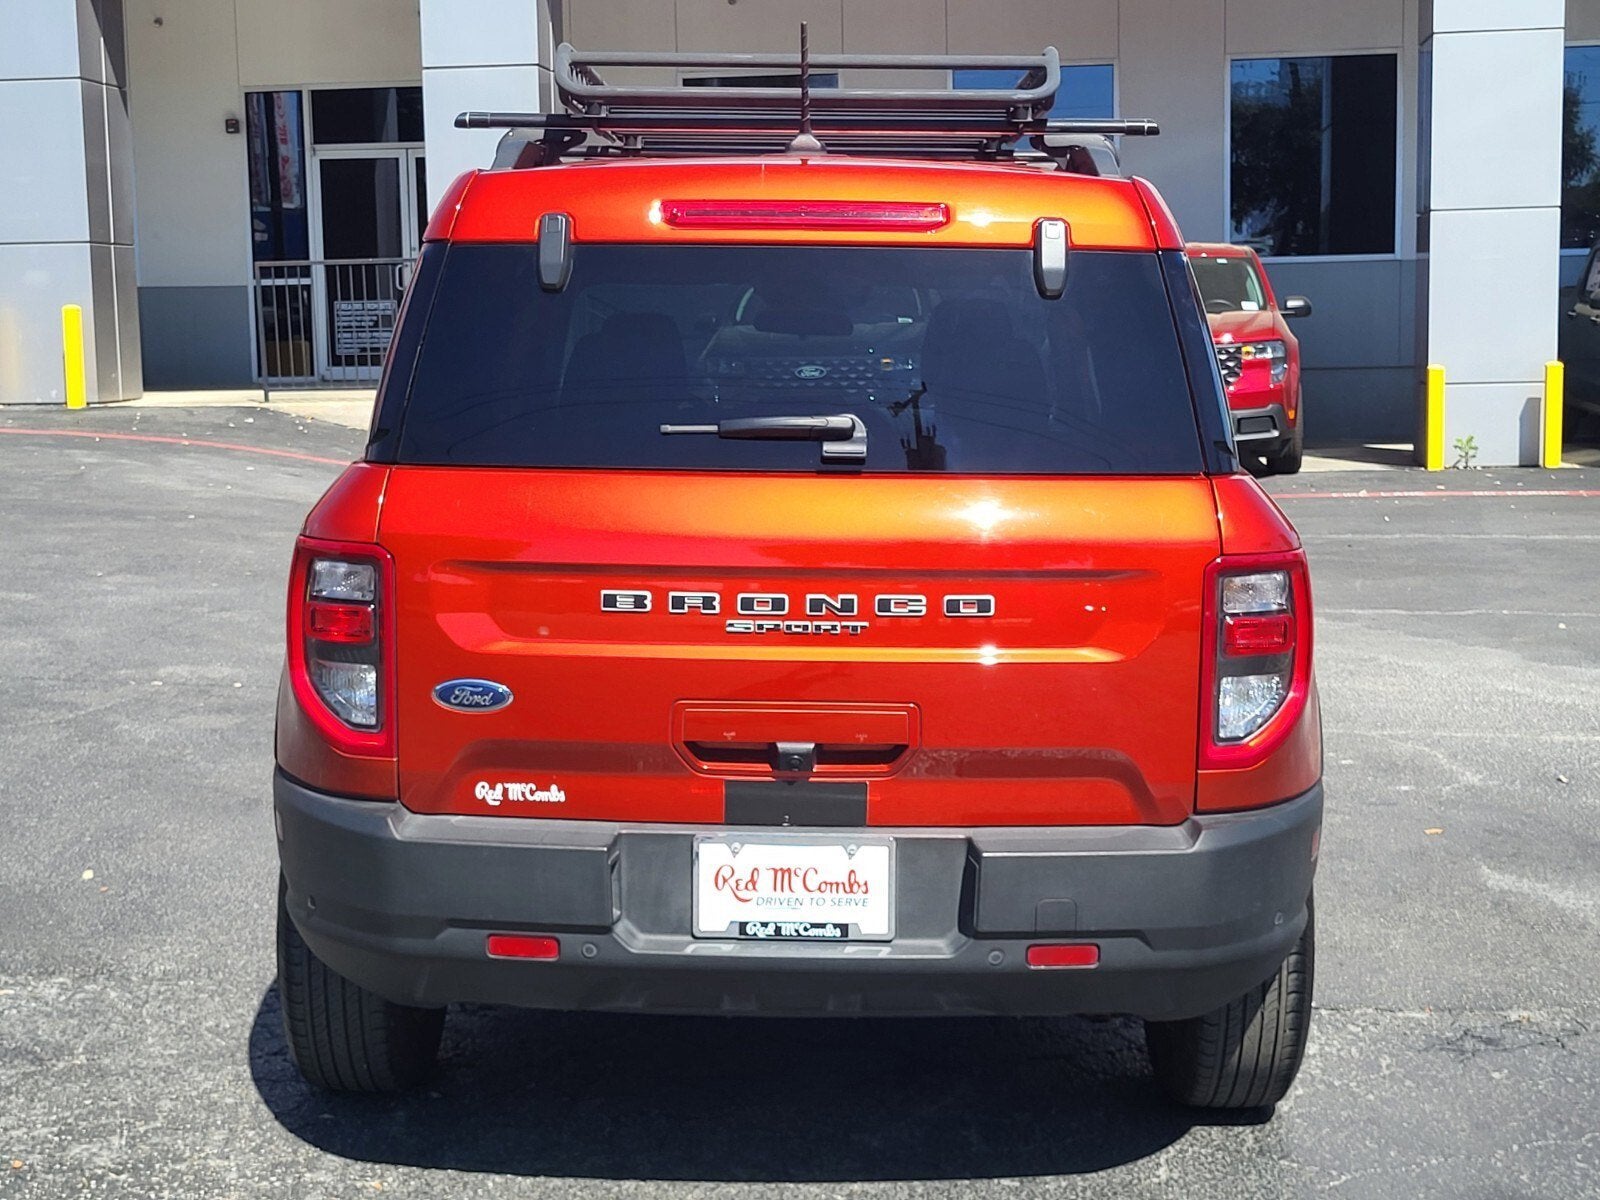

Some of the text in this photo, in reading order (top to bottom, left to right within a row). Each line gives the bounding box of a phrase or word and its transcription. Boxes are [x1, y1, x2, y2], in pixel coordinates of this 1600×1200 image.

[601, 590, 995, 617] BRONCO
[725, 619, 868, 634] SPORT
[450, 686, 493, 706] Ford
[475, 781, 566, 806] Red McCombs
[714, 864, 869, 903] Red McCombs
[756, 896, 868, 908] DRIVEN TO SERVE
[745, 921, 842, 938] Red McCombs
